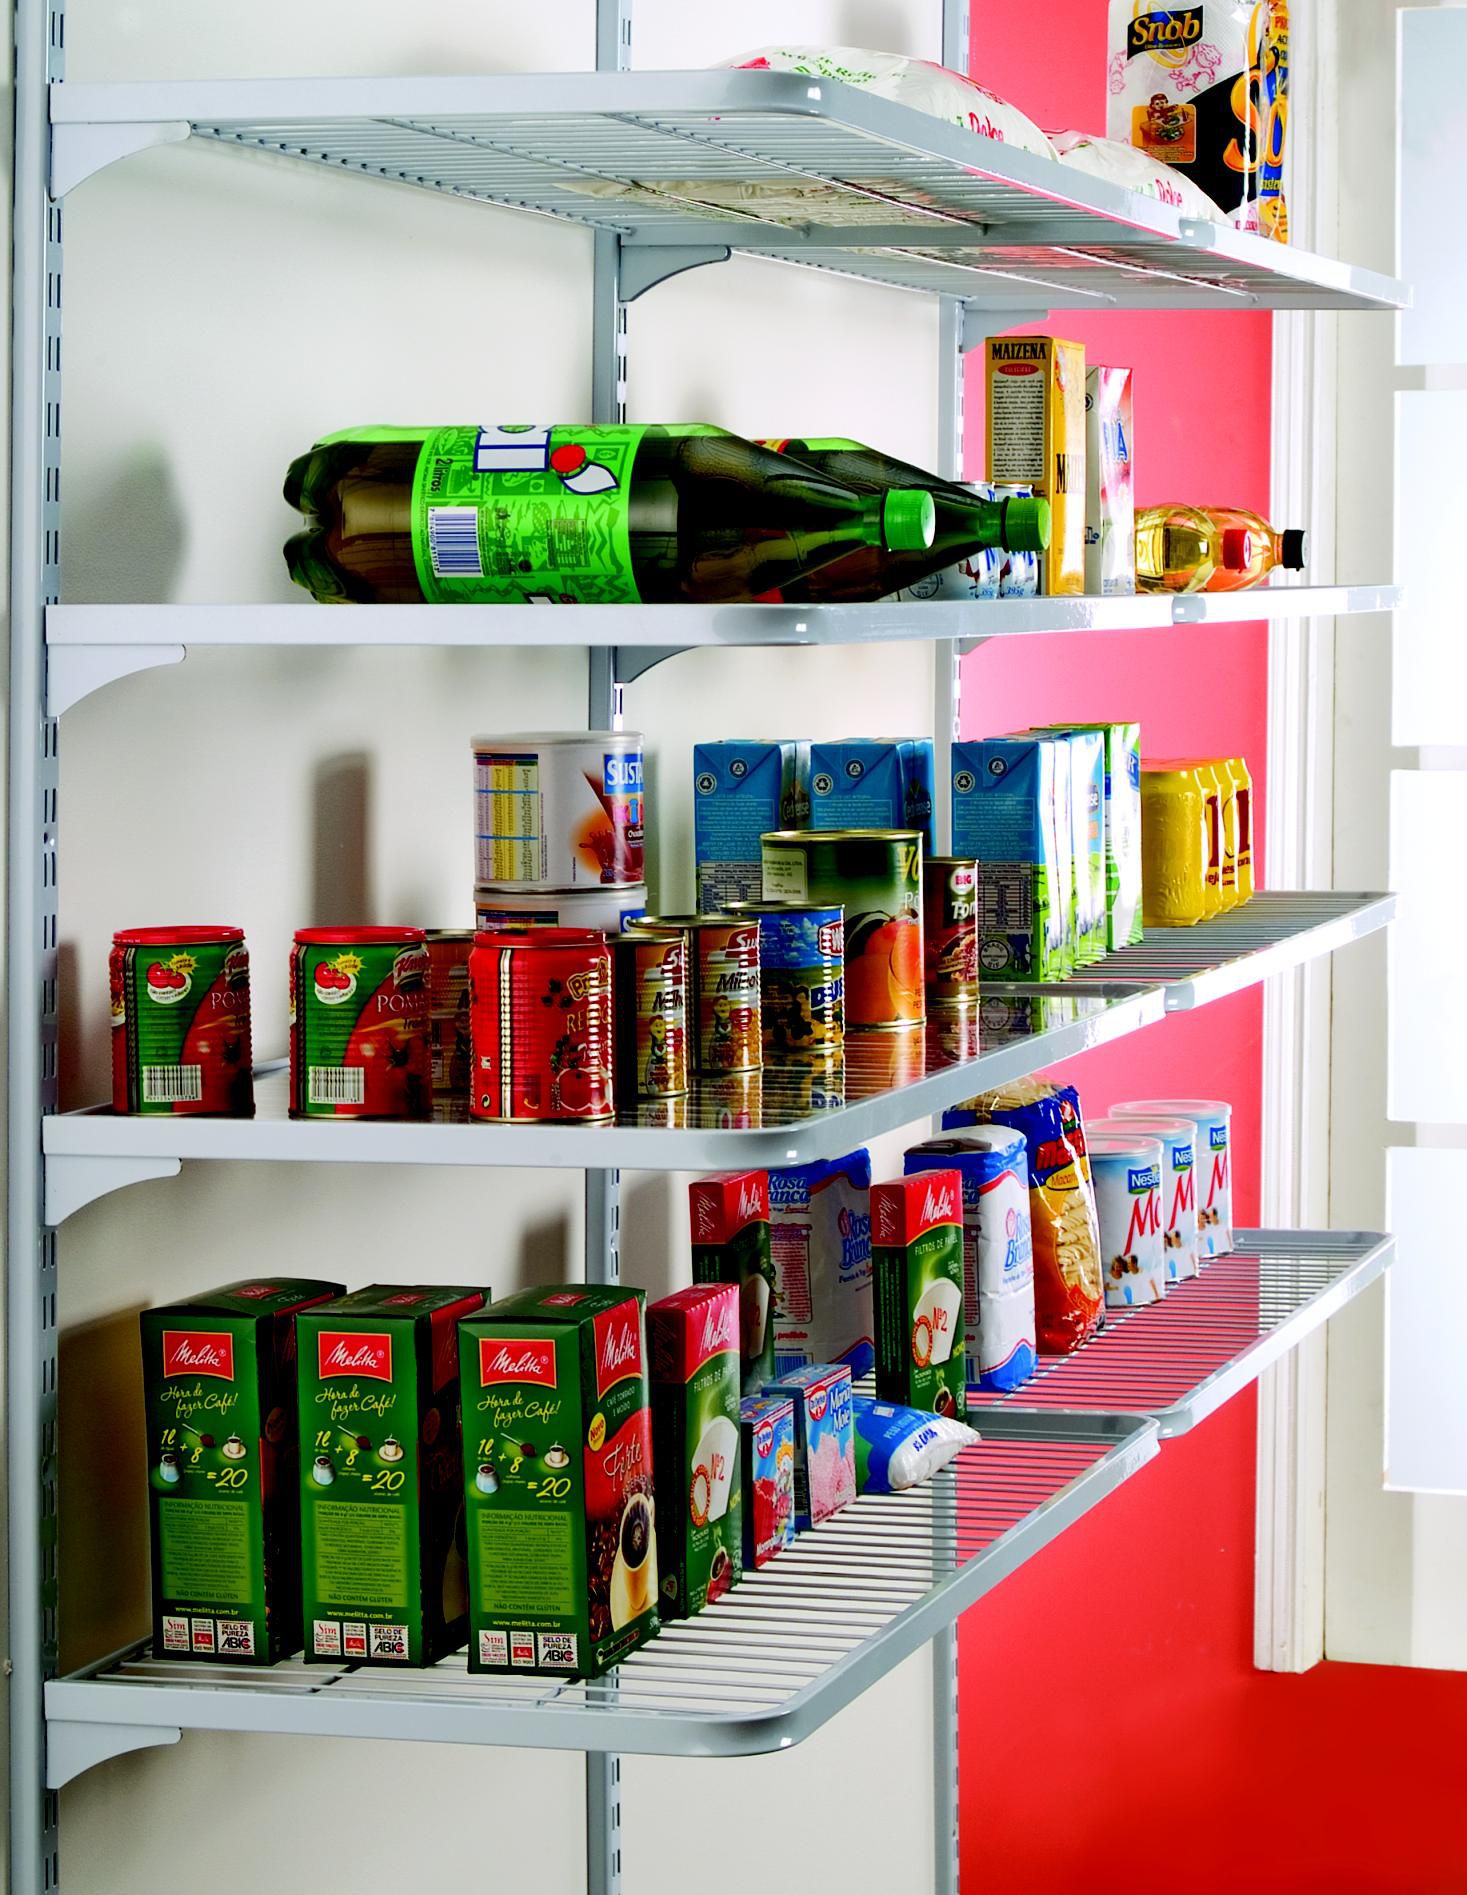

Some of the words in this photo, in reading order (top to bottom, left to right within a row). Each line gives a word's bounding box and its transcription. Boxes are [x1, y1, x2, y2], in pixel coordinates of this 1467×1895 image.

[1132, 12, 1200, 46] Snob
[991, 343, 1047, 360] MAIZENA
[955, 875, 973, 886] BIG
[920, 1184, 954, 1226] Melitta
[914, 1241, 936, 1256] FILTROS
[170, 1339, 221, 1367] Melitta
[324, 1340, 380, 1368] Melitta
[600, 1321, 637, 1376] Melitta
[486, 1346, 543, 1375] Melitta
[204, 1393, 238, 1415] Café!
[361, 1394, 397, 1417] Café!
[524, 1400, 561, 1424] Café!
[221, 1637, 251, 1649] ABIC
[374, 1641, 405, 1654] ABIC
[543, 1649, 574, 1663] ABIC
